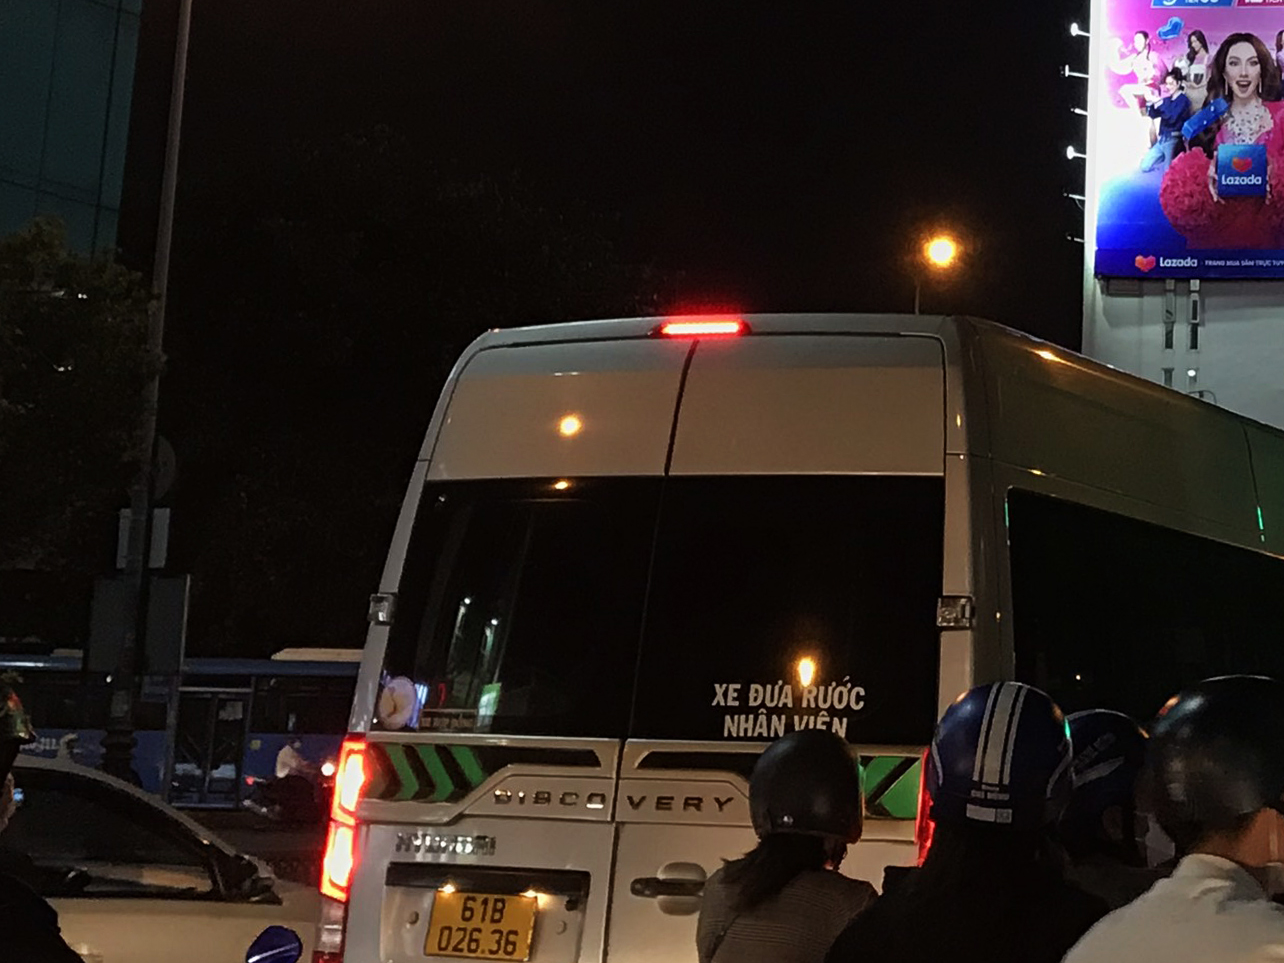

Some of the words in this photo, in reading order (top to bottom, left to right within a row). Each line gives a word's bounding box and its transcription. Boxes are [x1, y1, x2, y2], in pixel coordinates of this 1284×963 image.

[1221, 174, 1263, 185] Lazada
[1159, 256, 1198, 268] Lazada
[712, 683, 741, 707] XE
[748, 680, 793, 708] ĐƯA
[801, 675, 866, 711] RƯỚC
[723, 708, 786, 738] NHÂN
[793, 710, 848, 738] VIÊN
[461, 895, 507, 924] 61B
[437, 925, 519, 956] 026.36
